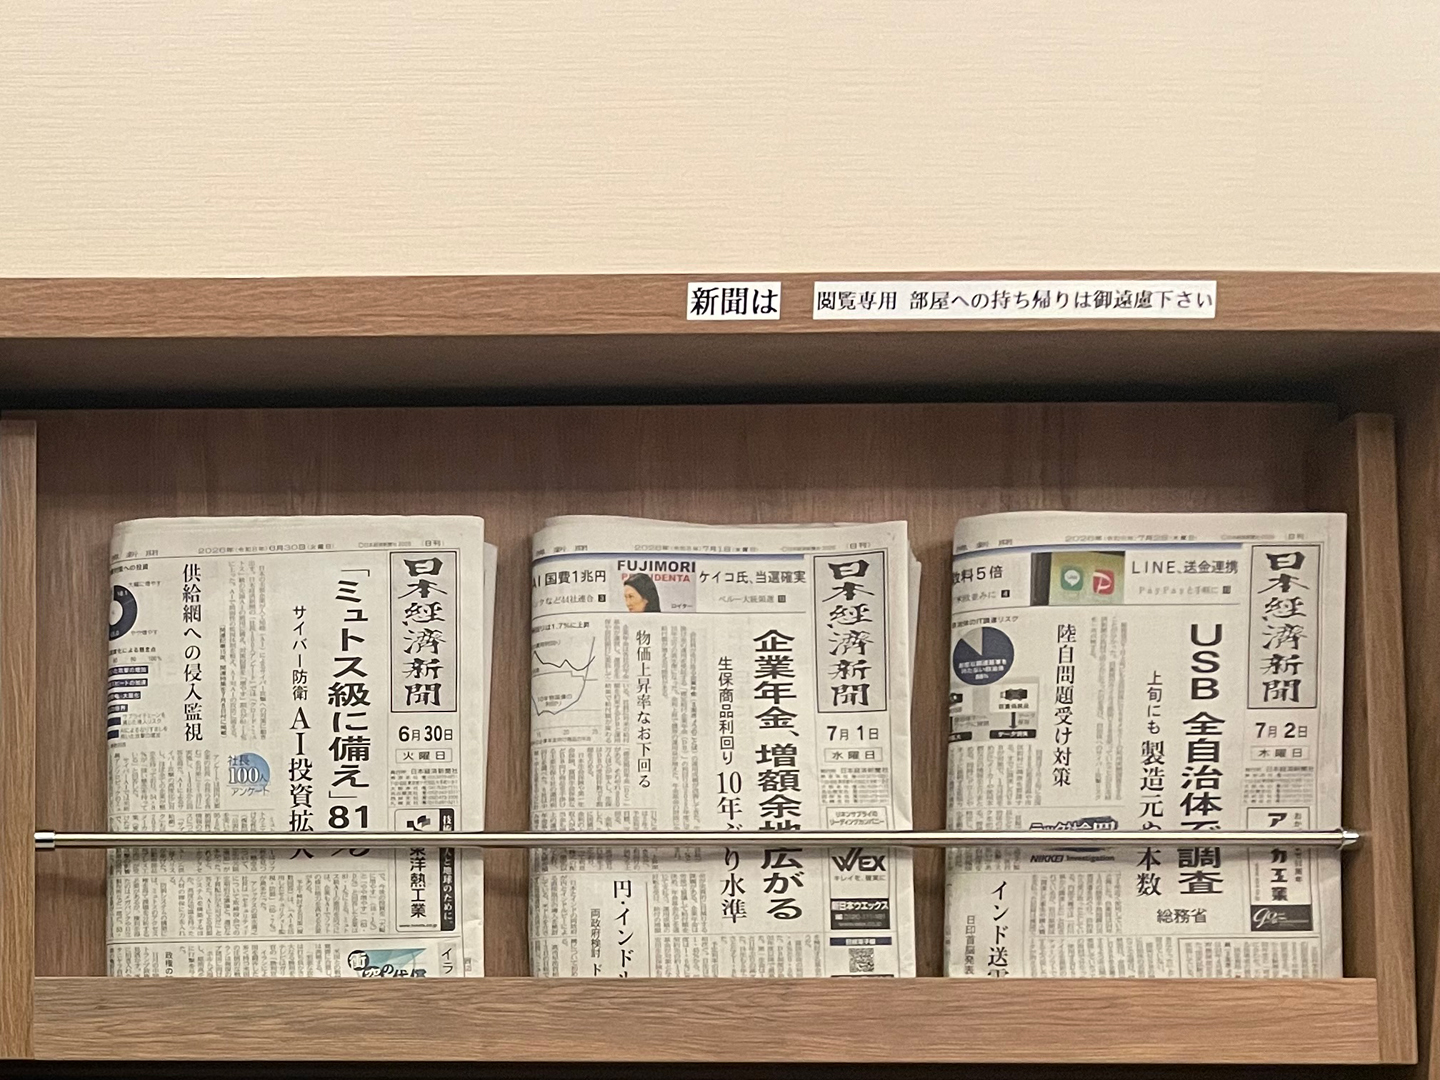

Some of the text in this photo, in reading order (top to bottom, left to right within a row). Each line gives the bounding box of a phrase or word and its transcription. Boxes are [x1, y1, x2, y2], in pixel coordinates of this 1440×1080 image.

[690, 287, 778, 316] 新聞は
[816, 290, 1213, 311] 閲覧専用 部屋への持ち帰りは御遠慮下さい
[617, 560, 696, 573] FUJIMORI
[1131, 560, 1239, 575] LINE、送金連携
[699, 570, 807, 585] ケイコ氏、当選確実
[182, 563, 203, 742] 供給網への侵入監視
[327, 569, 371, 857] 「ミュトス級に備え」81
[635, 629, 652, 788] 物価上昇率なお下回る
[1053, 623, 1077, 788] 陸自問題受け対策
[398, 725, 453, 742] 6月30日
[827, 725, 879, 741] 7月1日
[1255, 722, 1308, 739] 7月2日
[227, 755, 250, 767] 社長
[402, 751, 446, 760] 火曜日
[831, 751, 875, 760] 水曜日
[1258, 748, 1303, 758] 木曜日
[717, 656, 747, 924] 生保商品利回り10年り水準
[831, 847, 887, 872] WEX
[1030, 855, 1064, 863] NIKKEI
[1156, 907, 1208, 924] 総務省
[613, 879, 634, 978] 円・インド
